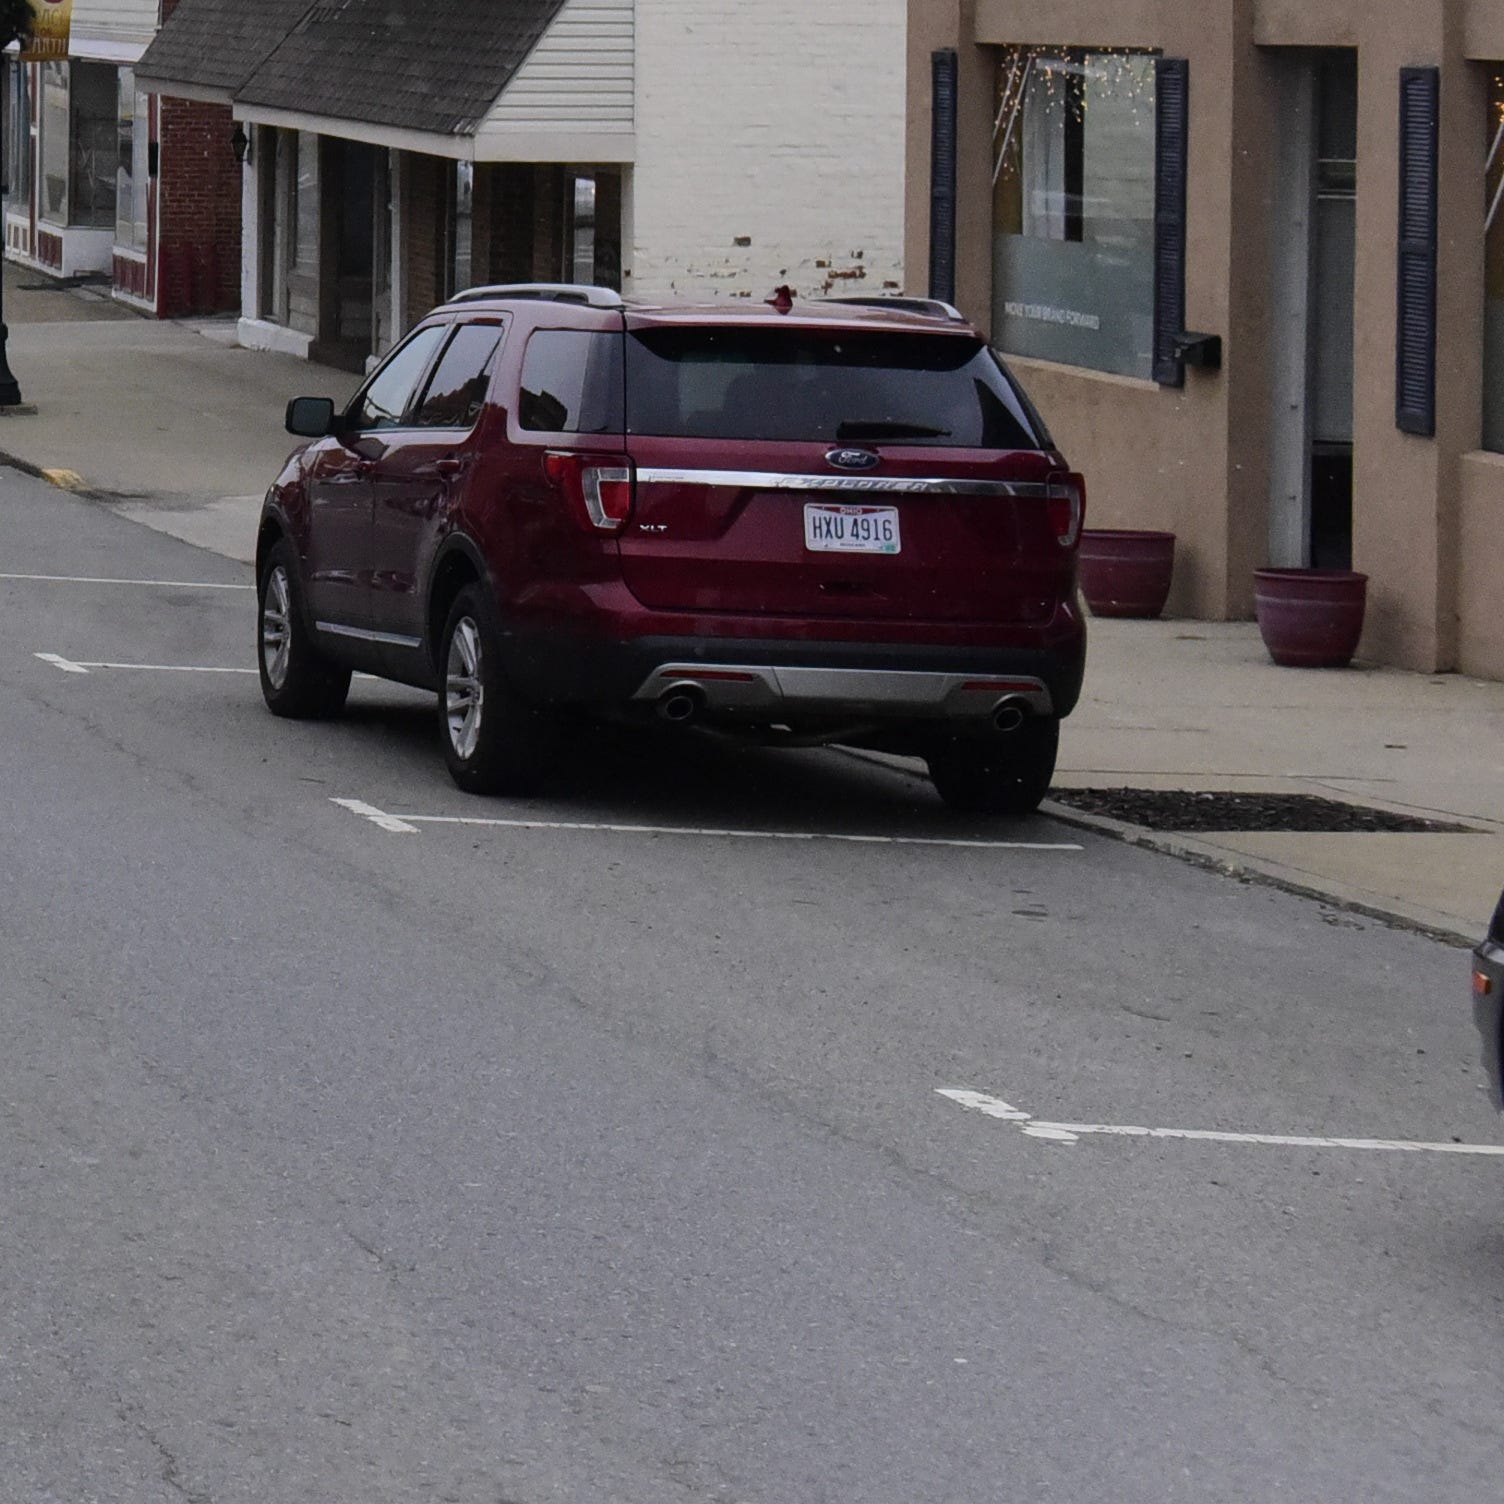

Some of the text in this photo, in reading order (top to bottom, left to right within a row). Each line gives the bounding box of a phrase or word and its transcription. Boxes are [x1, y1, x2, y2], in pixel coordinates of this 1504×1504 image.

[32, 37, 67, 53] ARTH
[837, 451, 868, 465] Ford
[778, 476, 929, 491] EXPLORER
[639, 524, 668, 532] XLT
[813, 516, 892, 541] HXU 4916
